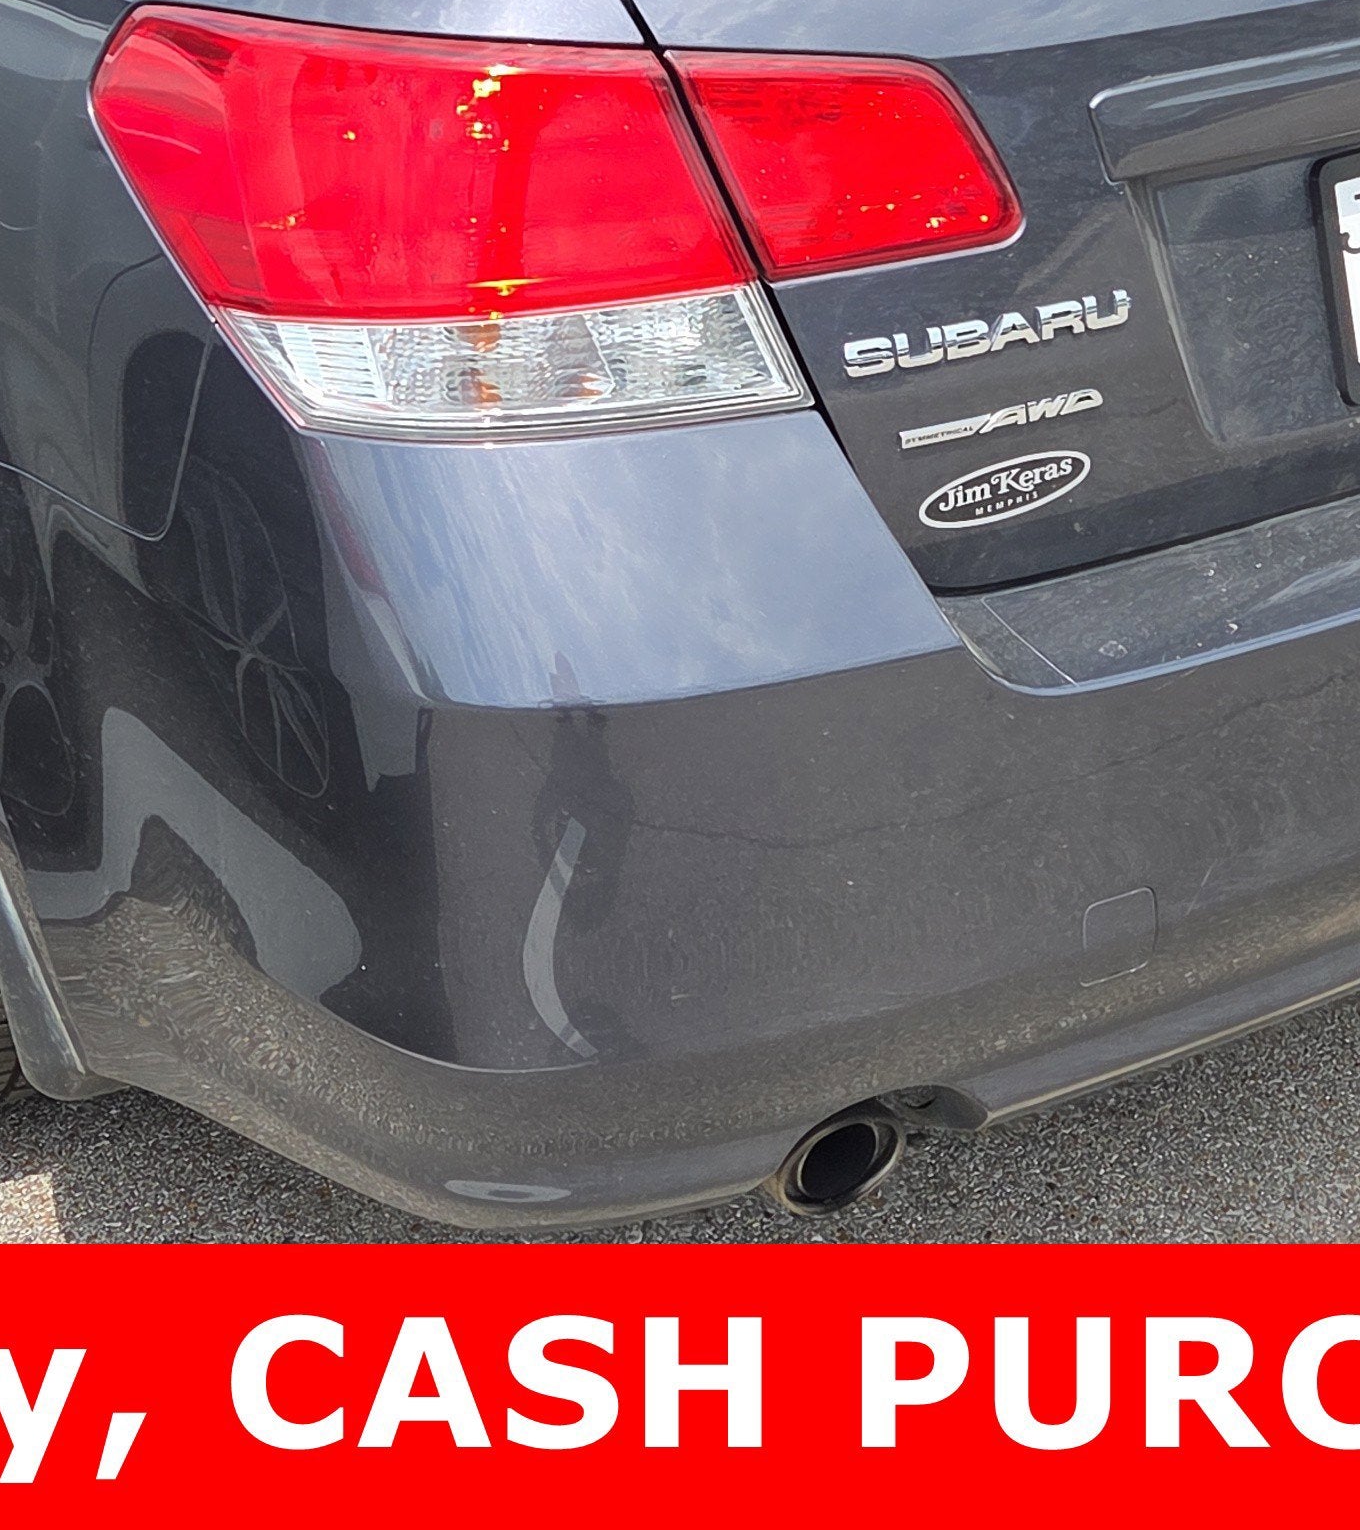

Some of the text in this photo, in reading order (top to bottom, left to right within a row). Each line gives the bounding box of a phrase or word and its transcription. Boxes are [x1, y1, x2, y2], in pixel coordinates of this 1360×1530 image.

[843, 289, 1131, 378] SUBARU
[979, 388, 1104, 434] AWD
[975, 490, 1039, 516] MEMPHIS
